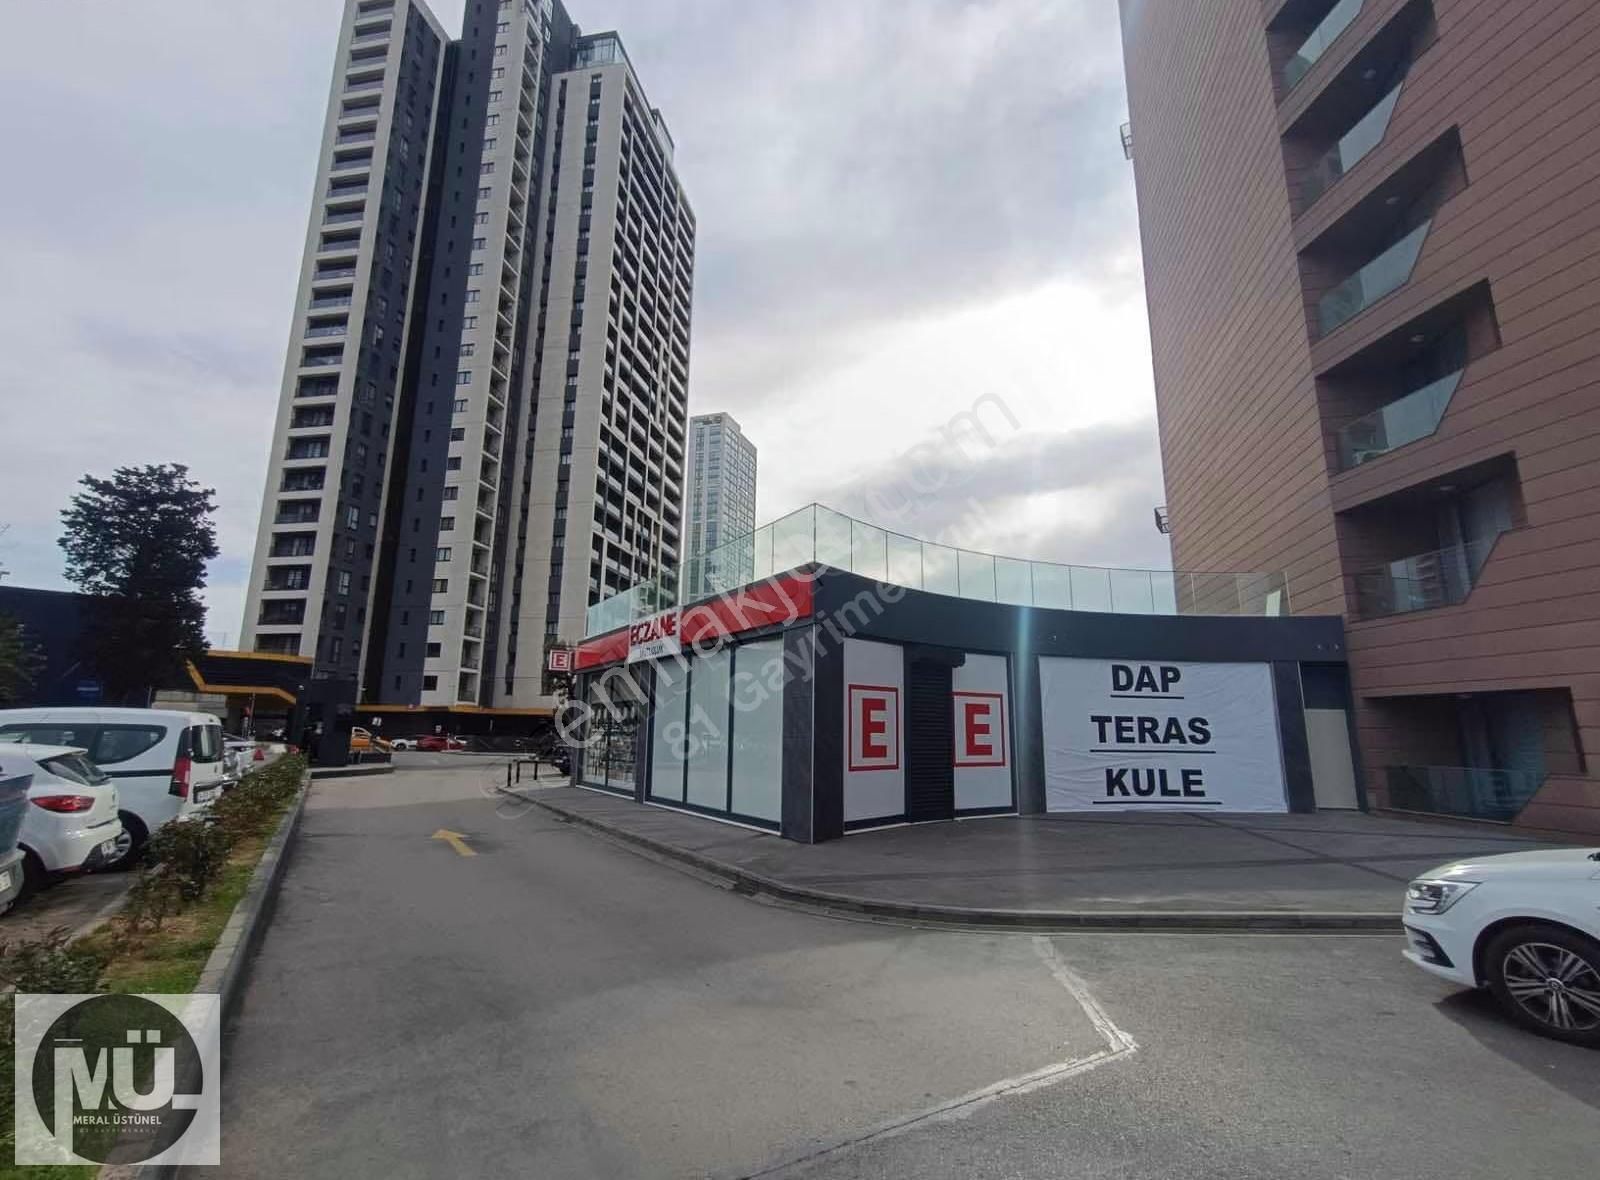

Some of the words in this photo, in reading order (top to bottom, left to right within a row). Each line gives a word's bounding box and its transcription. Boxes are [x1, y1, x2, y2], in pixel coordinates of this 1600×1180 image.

[630, 612, 677, 646] ECZANE
[555, 654, 567, 666] E
[1112, 664, 1181, 693] DAP
[862, 698, 887, 758] E
[965, 703, 992, 756] E
[1091, 715, 1211, 745] TERAS
[1105, 768, 1206, 797] KULE
